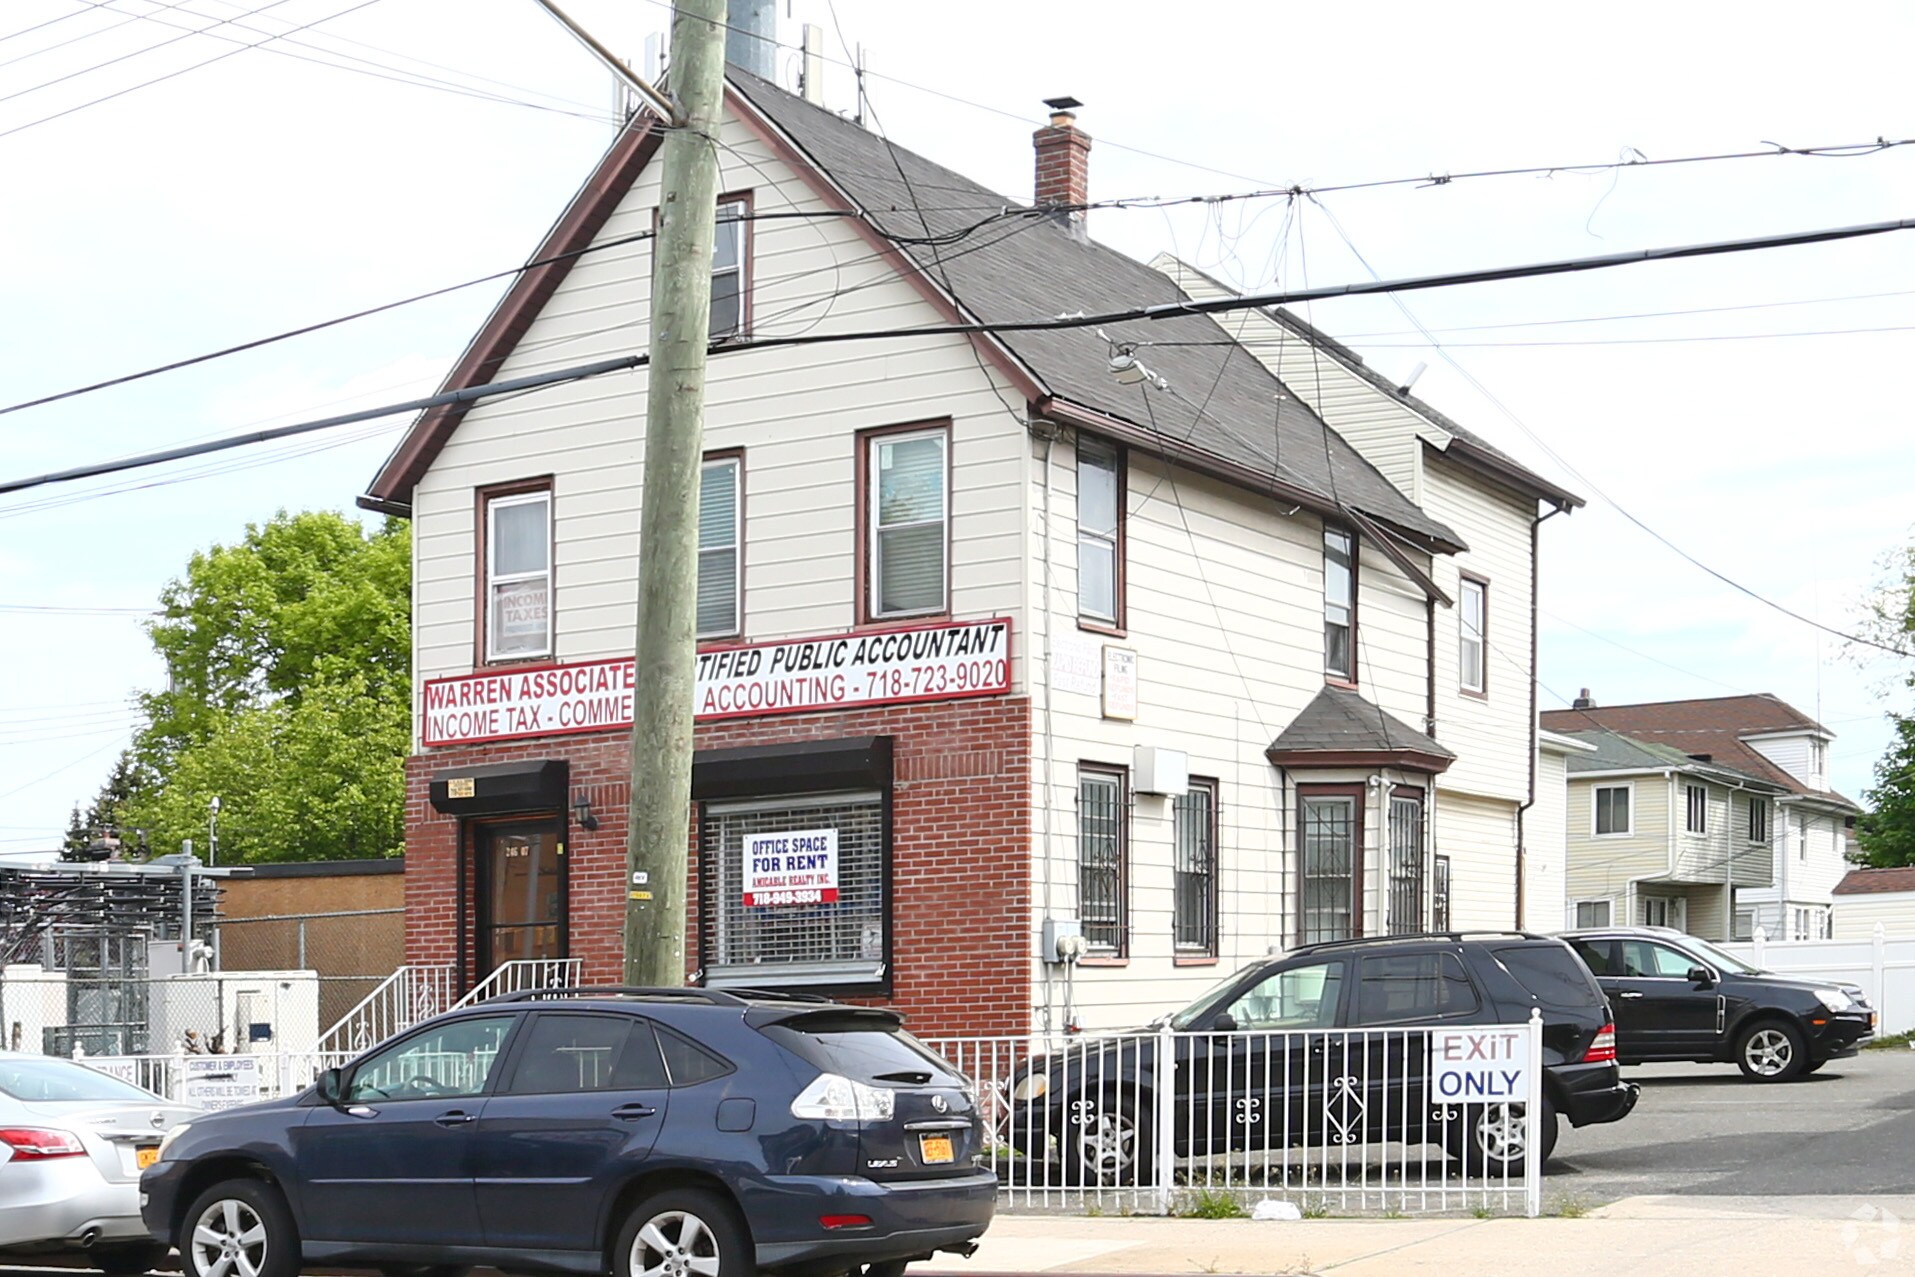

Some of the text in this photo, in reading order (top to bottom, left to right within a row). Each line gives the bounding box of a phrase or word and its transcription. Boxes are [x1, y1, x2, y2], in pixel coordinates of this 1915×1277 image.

[503, 592, 547, 608] INCOM
[505, 606, 547, 622] TAXES
[427, 624, 1005, 710] WARREN ASSOCIATE TIFIED PUBLIC ACCOUNTANT
[427, 709, 499, 741] INCOME
[507, 704, 541, 732] TAX
[559, 695, 632, 727] COMME
[702, 674, 845, 713] ACCOUNTING
[866, 659, 1007, 698] 718-723-9020
[752, 836, 827, 855] OFFICE SPACE
[752, 854, 828, 873] FOR RENT
[752, 876, 787, 888] AMICABLE
[788, 874, 814, 887] REALTY
[1439, 1070, 1522, 1096] ONLY
